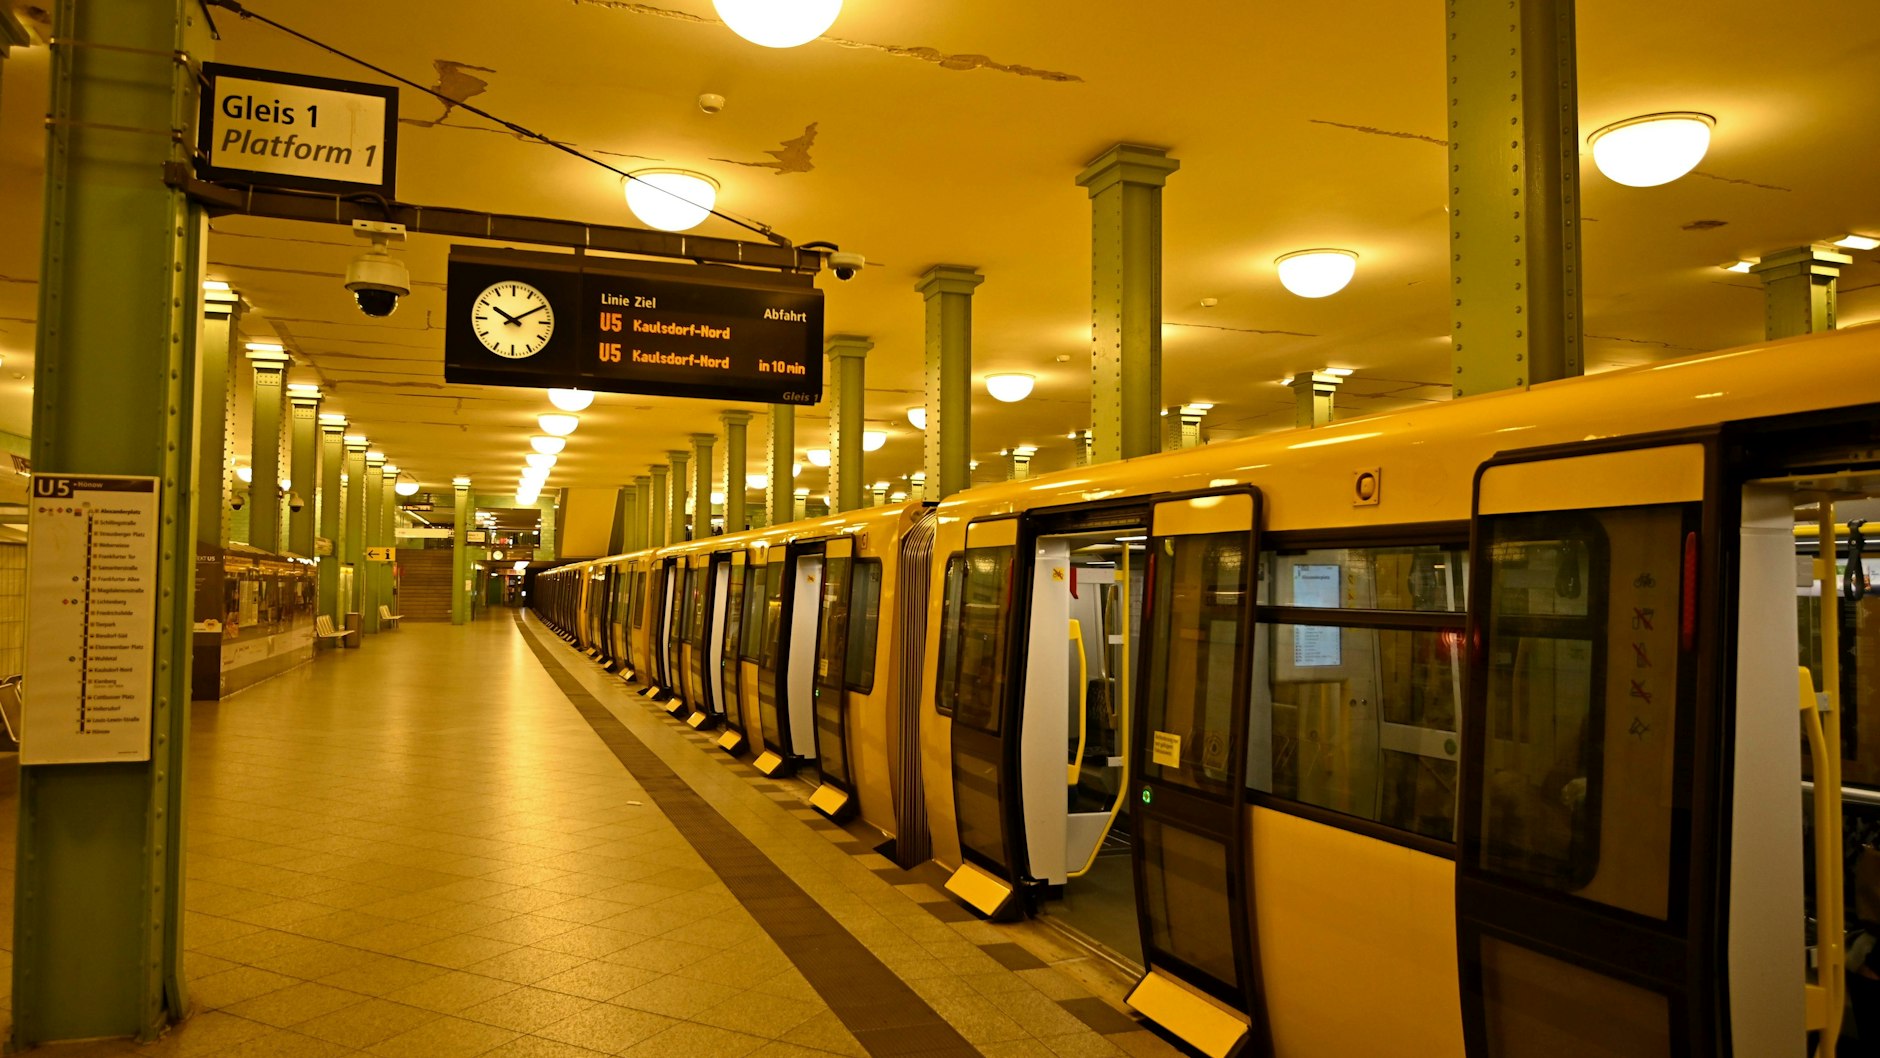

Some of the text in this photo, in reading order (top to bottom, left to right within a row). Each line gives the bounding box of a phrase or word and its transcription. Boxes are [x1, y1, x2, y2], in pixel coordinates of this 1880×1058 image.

[222, 95, 318, 128] Gleis 1
[221, 129, 377, 167] Platform 1
[601, 293, 656, 308] Linie Ziel
[600, 312, 622, 332] U5
[763, 308, 807, 322] Abfahrt
[633, 319, 731, 340] Kaulsdorf-Nord
[599, 342, 621, 363] U5
[632, 349, 730, 369] Kaulsdorf-Nord
[758, 359, 806, 375] in 10 min
[782, 391, 810, 401] Gleis
